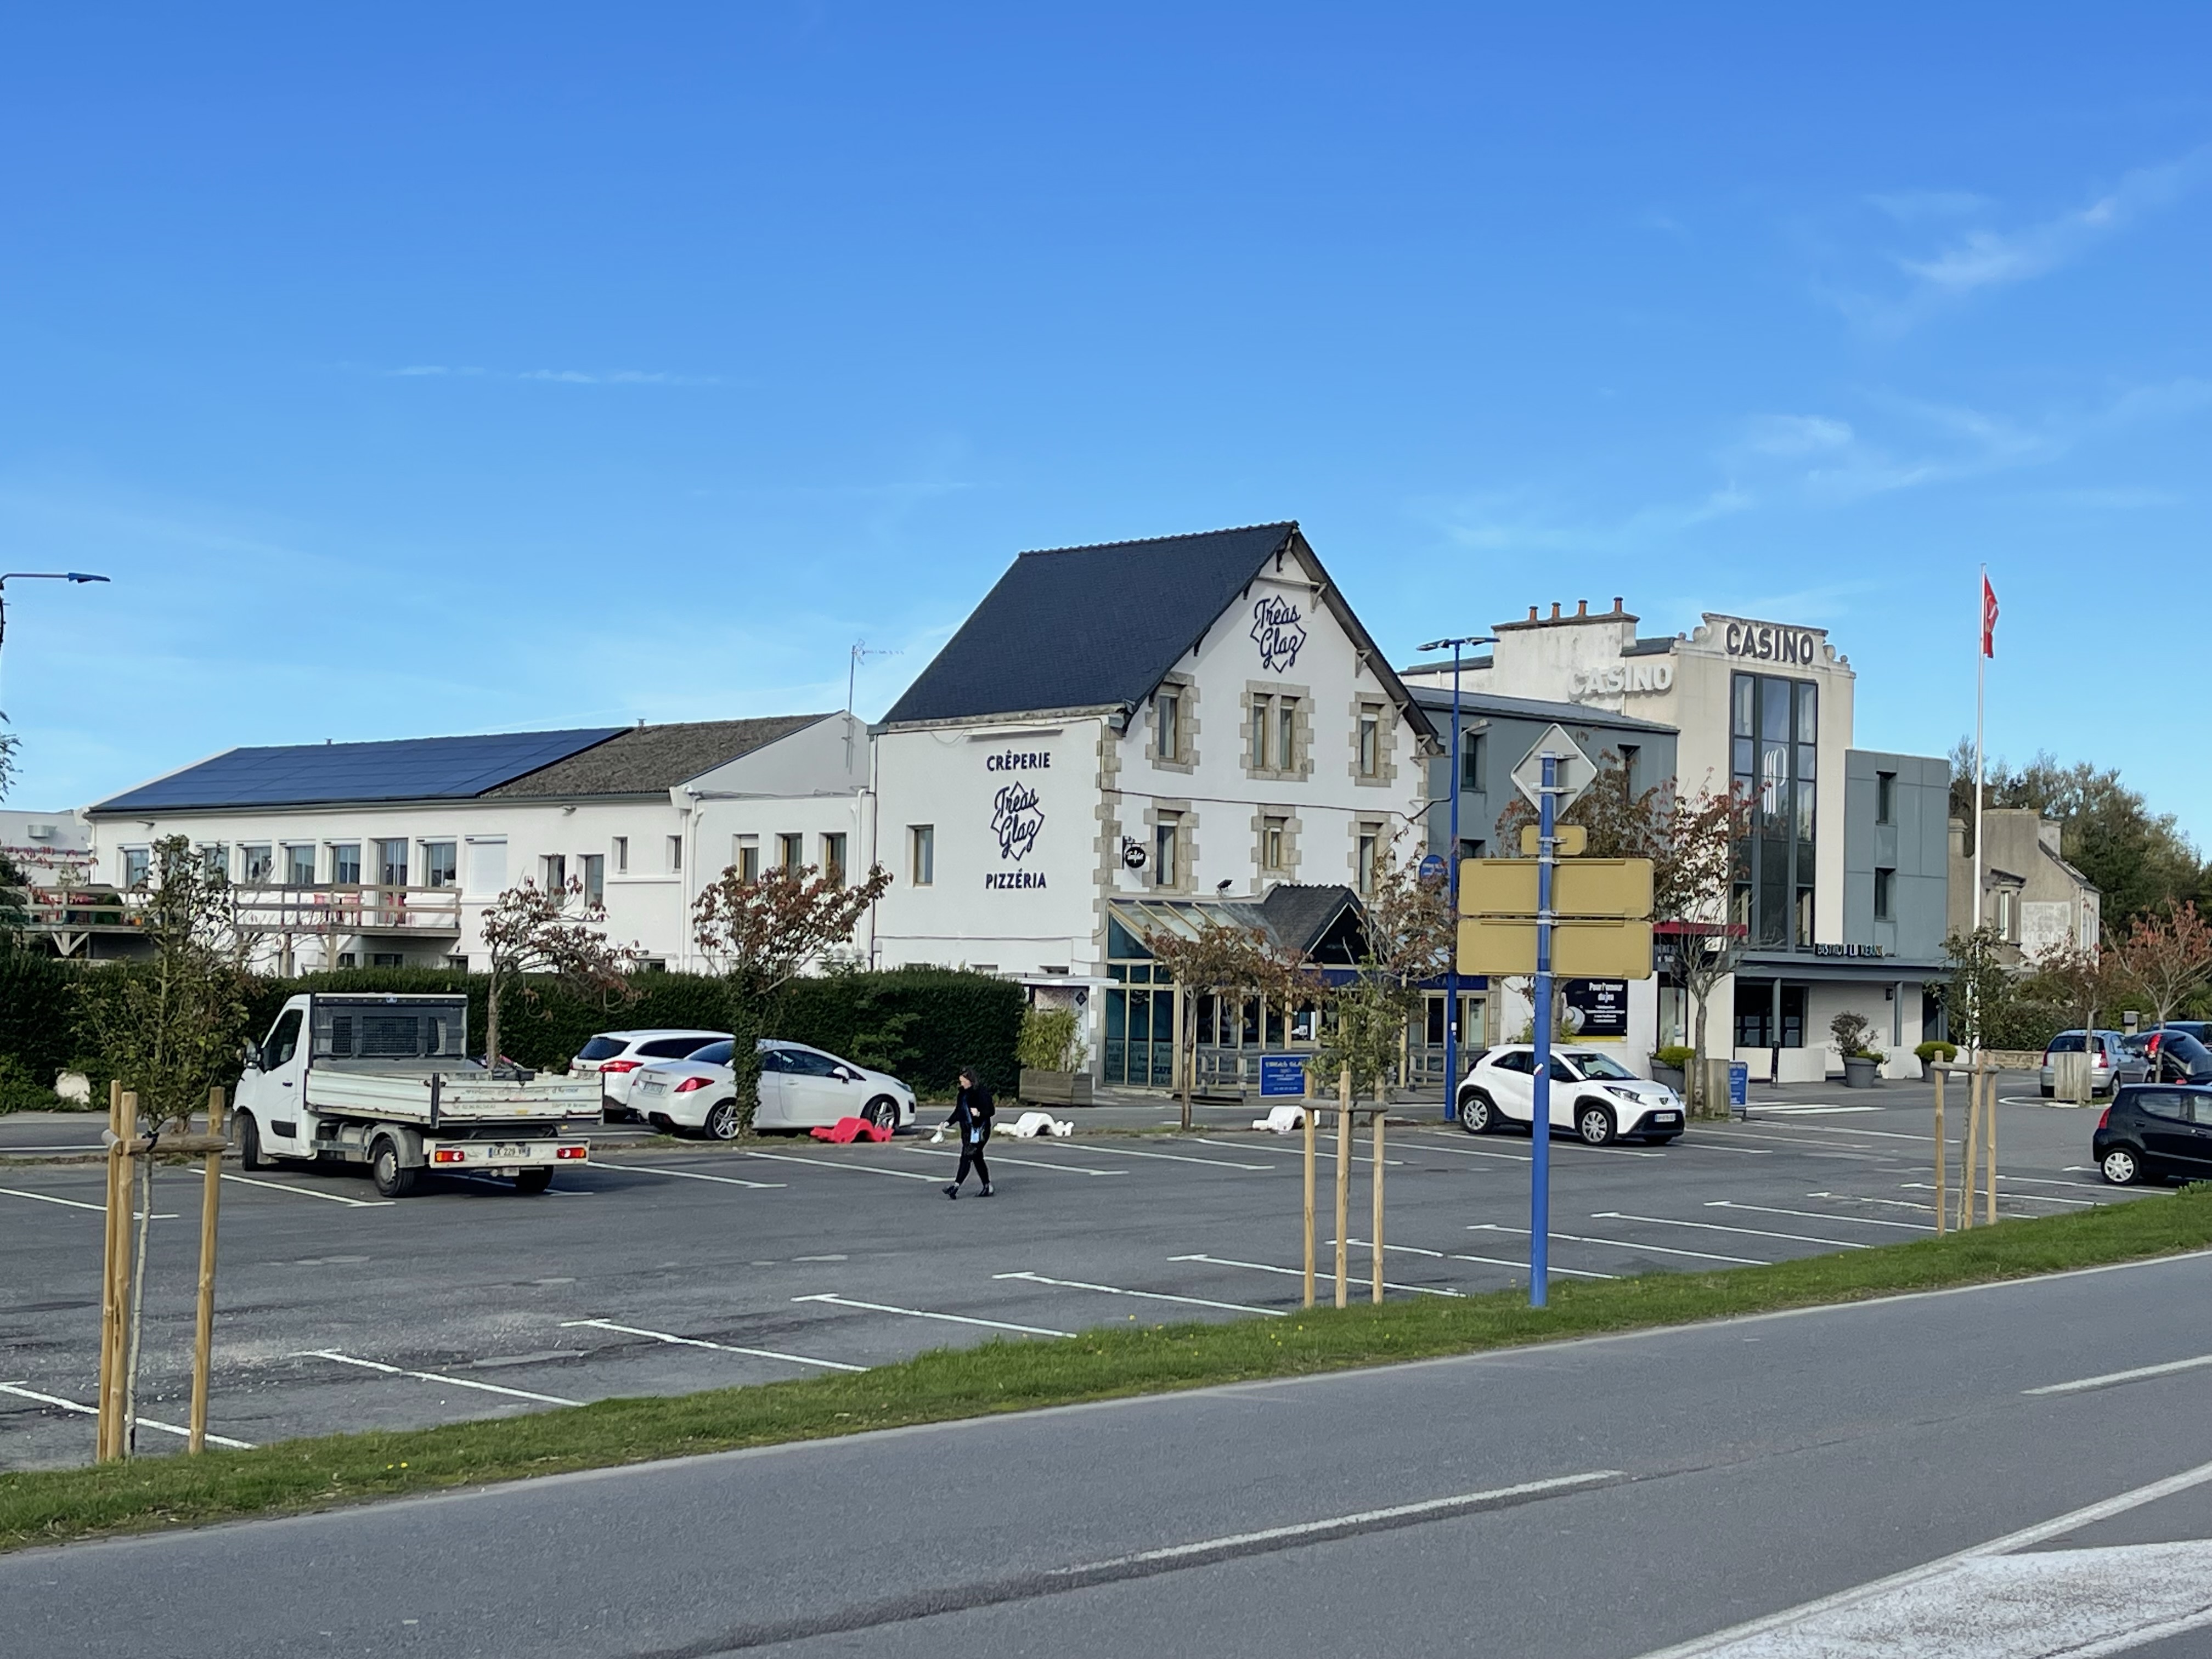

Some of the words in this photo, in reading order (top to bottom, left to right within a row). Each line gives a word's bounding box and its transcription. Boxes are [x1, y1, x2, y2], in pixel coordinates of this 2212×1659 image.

[1254, 598, 1301, 630] Treas
[1260, 627, 1298, 669] Glaz
[1725, 623, 1814, 665] CASINO
[1568, 663, 1674, 695] CASINO
[986, 749, 1051, 771] CRÊPERIE
[994, 786, 1040, 819] Treas
[999, 814, 1036, 859] Glaz
[985, 867, 1047, 889] PIZZÉRIA
